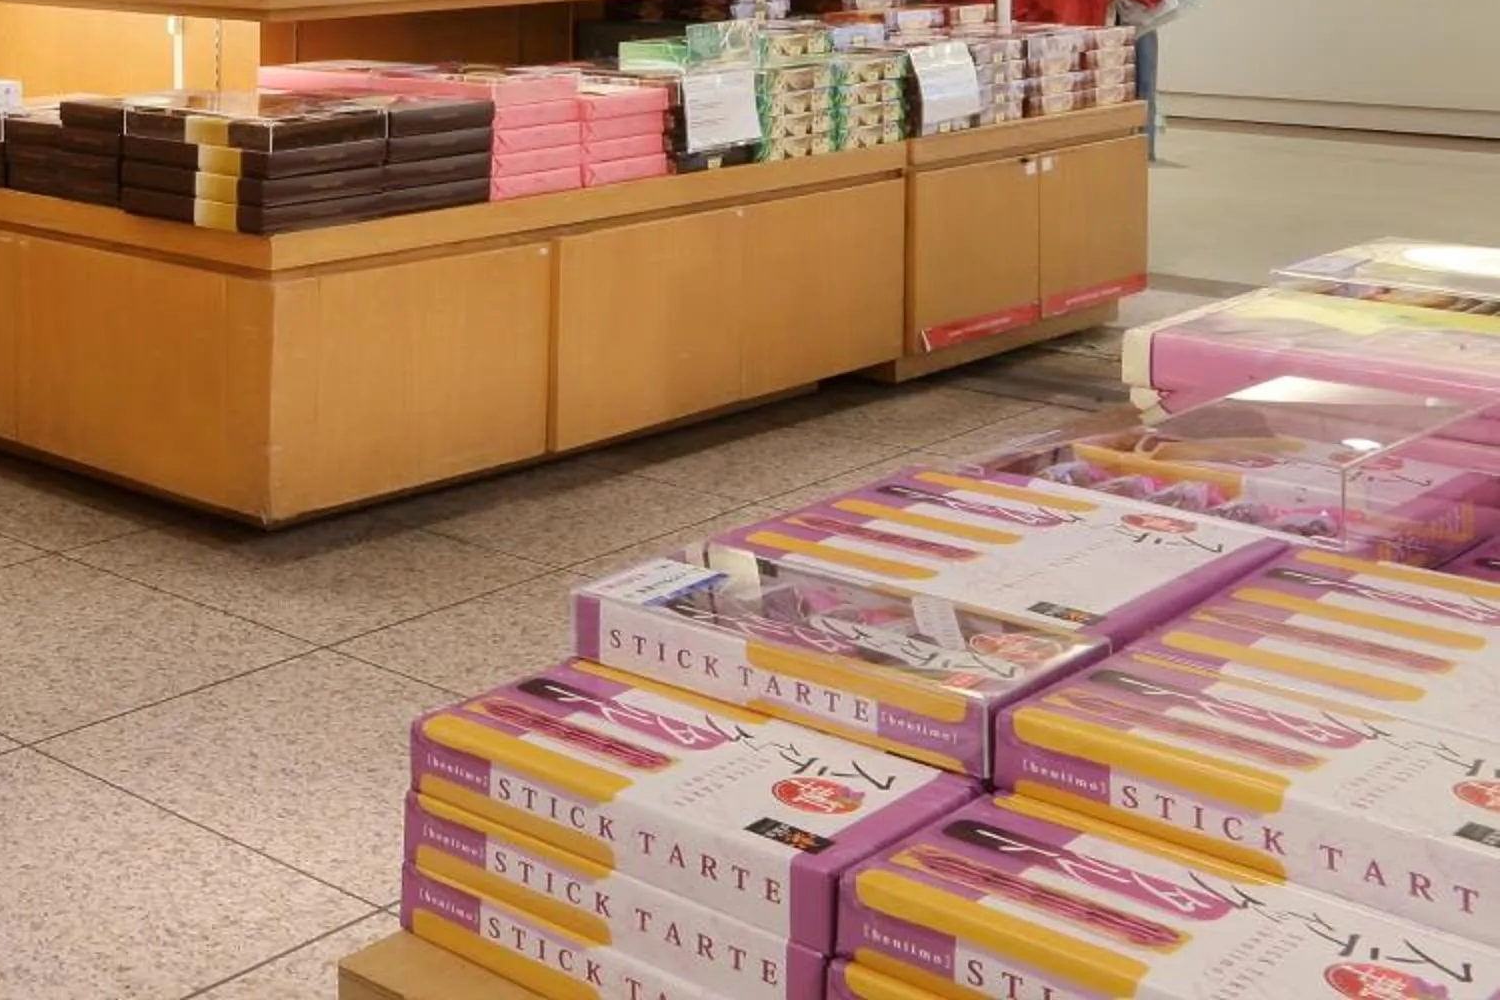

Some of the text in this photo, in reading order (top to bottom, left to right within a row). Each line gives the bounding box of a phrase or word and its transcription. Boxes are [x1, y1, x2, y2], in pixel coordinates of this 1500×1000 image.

[609, 628, 720, 678] STICK
[737, 665, 870, 723] TARTE
[499, 777, 615, 841] STICK
[638, 830, 782, 905] TARTE
[1121, 784, 1287, 855] STICK
[1319, 843, 1480, 915] TART
[488, 916, 603, 986] STICK
[494, 850, 610, 918] STICK
[635, 907, 778, 986] TARTE
